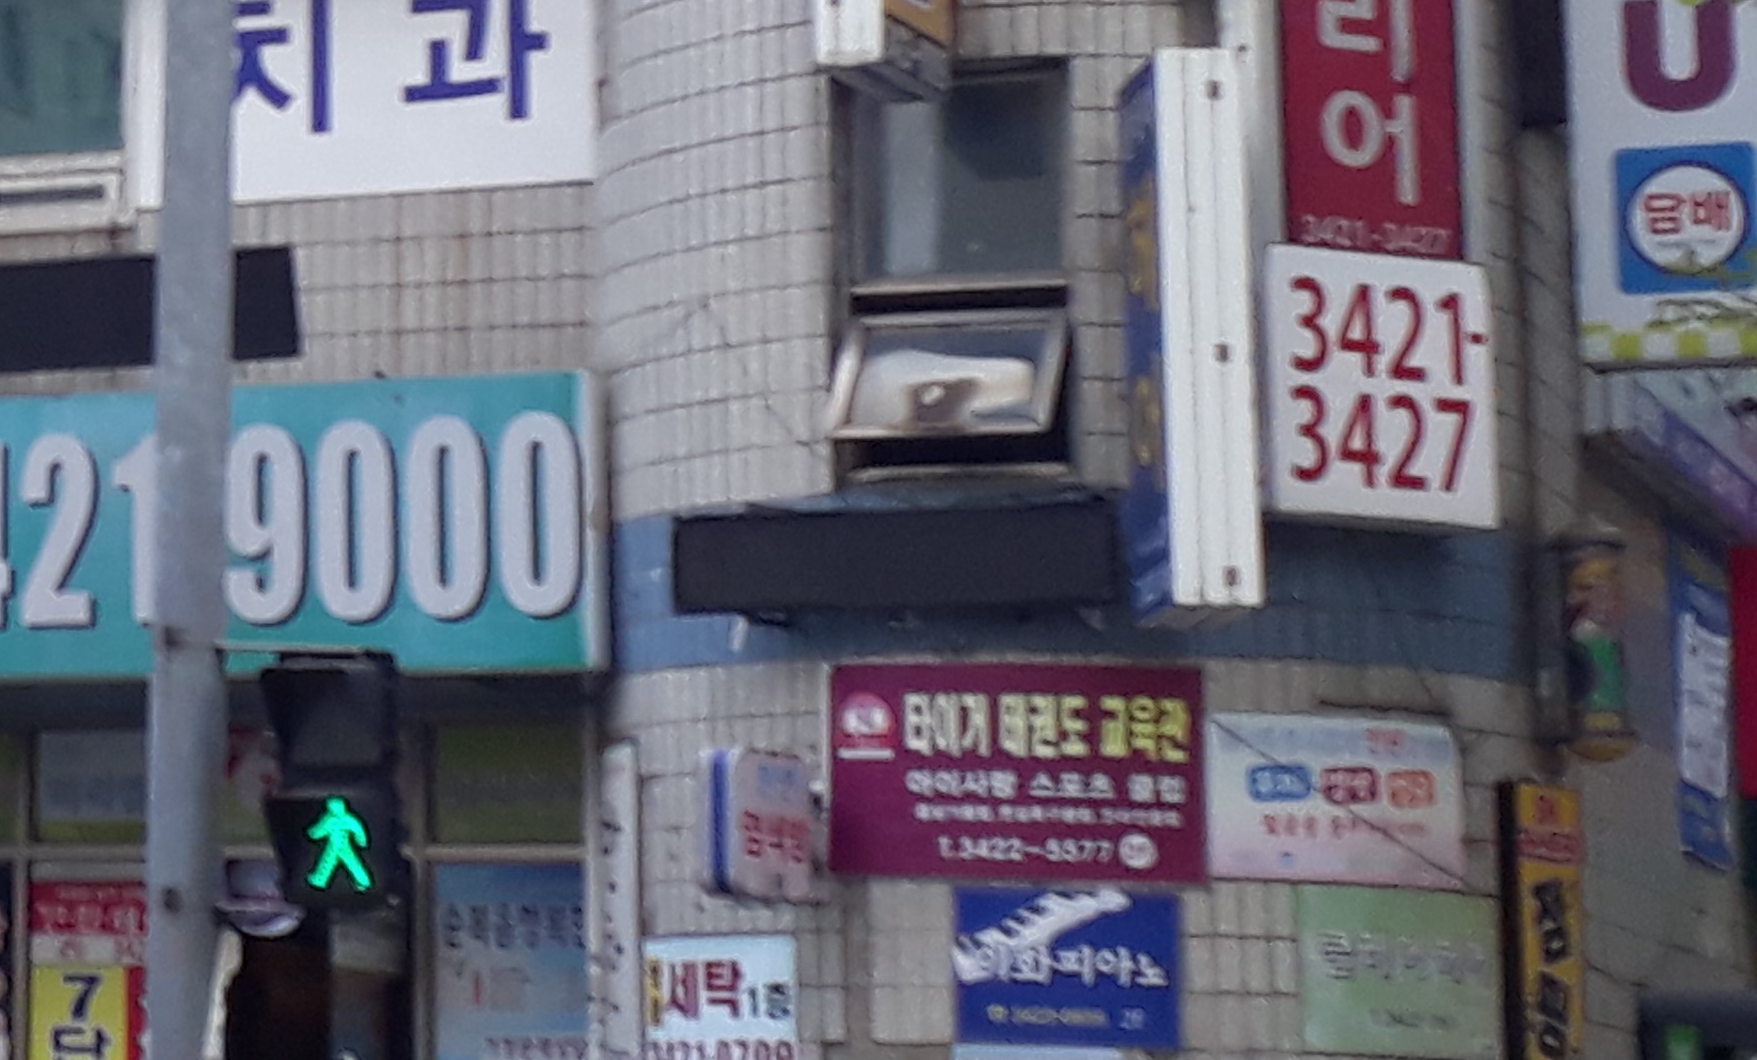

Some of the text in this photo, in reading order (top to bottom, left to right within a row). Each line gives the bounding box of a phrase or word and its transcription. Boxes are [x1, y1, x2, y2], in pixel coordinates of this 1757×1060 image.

[1291, 384, 1477, 492] 3427
[223, 408, 583, 625] 9000
[903, 692, 1193, 765] 타이거 태권도 교육관
